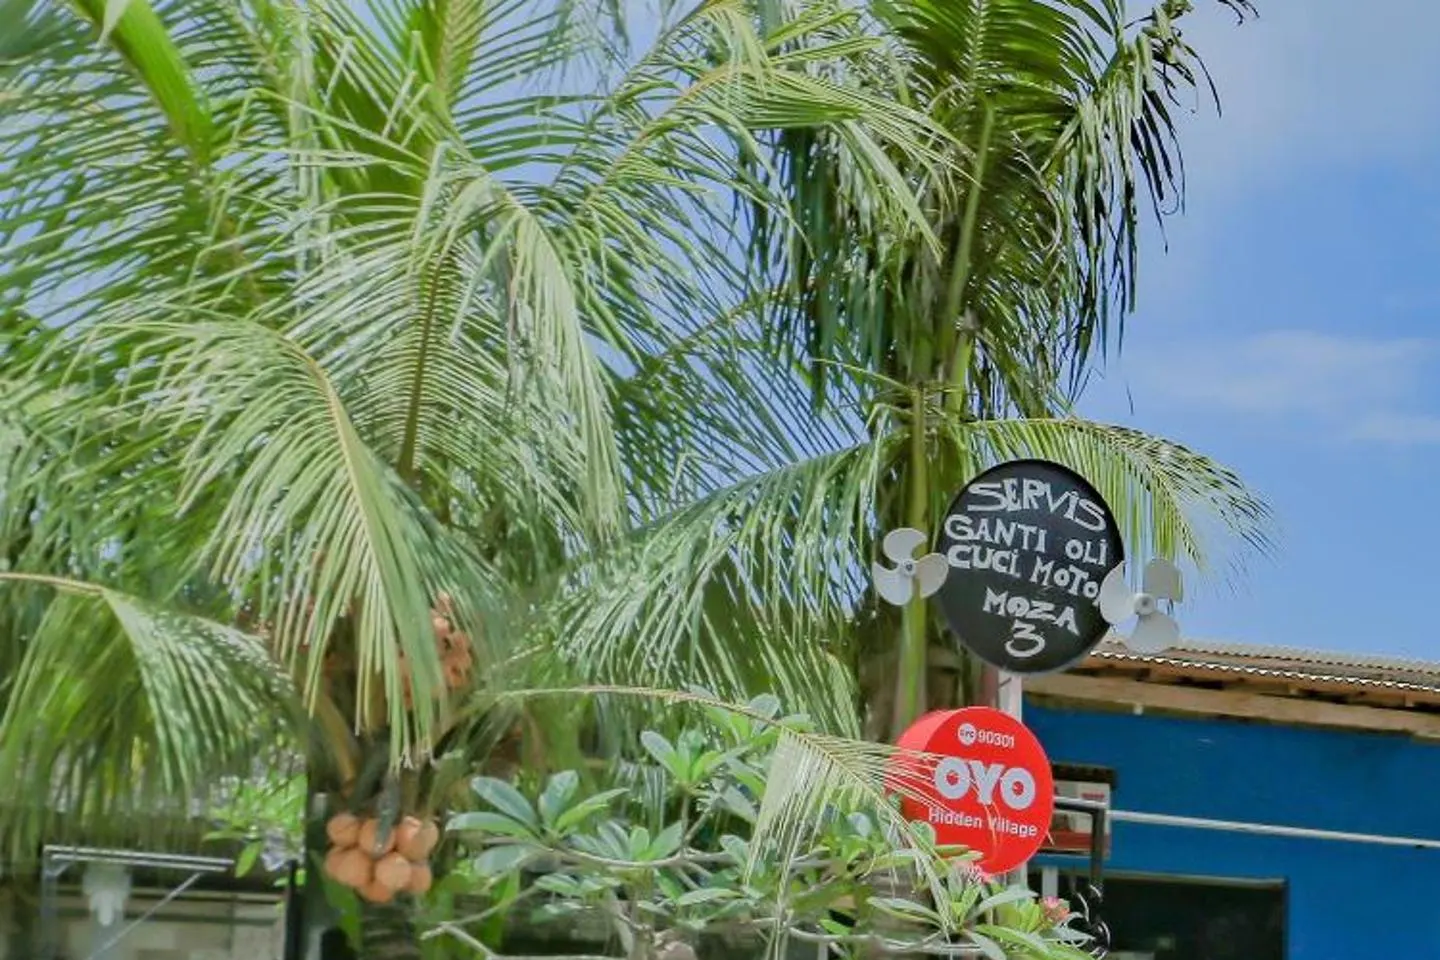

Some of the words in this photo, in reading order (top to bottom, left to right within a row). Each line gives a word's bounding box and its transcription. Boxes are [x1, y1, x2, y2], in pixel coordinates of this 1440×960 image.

[944, 514, 1047, 553] GANTI
[1029, 558, 1101, 604] MOTO
[978, 729, 1015, 749] 90301
[934, 756, 1036, 811] OYO
[928, 807, 983, 829] Hidden
[989, 816, 1038, 838] Village
